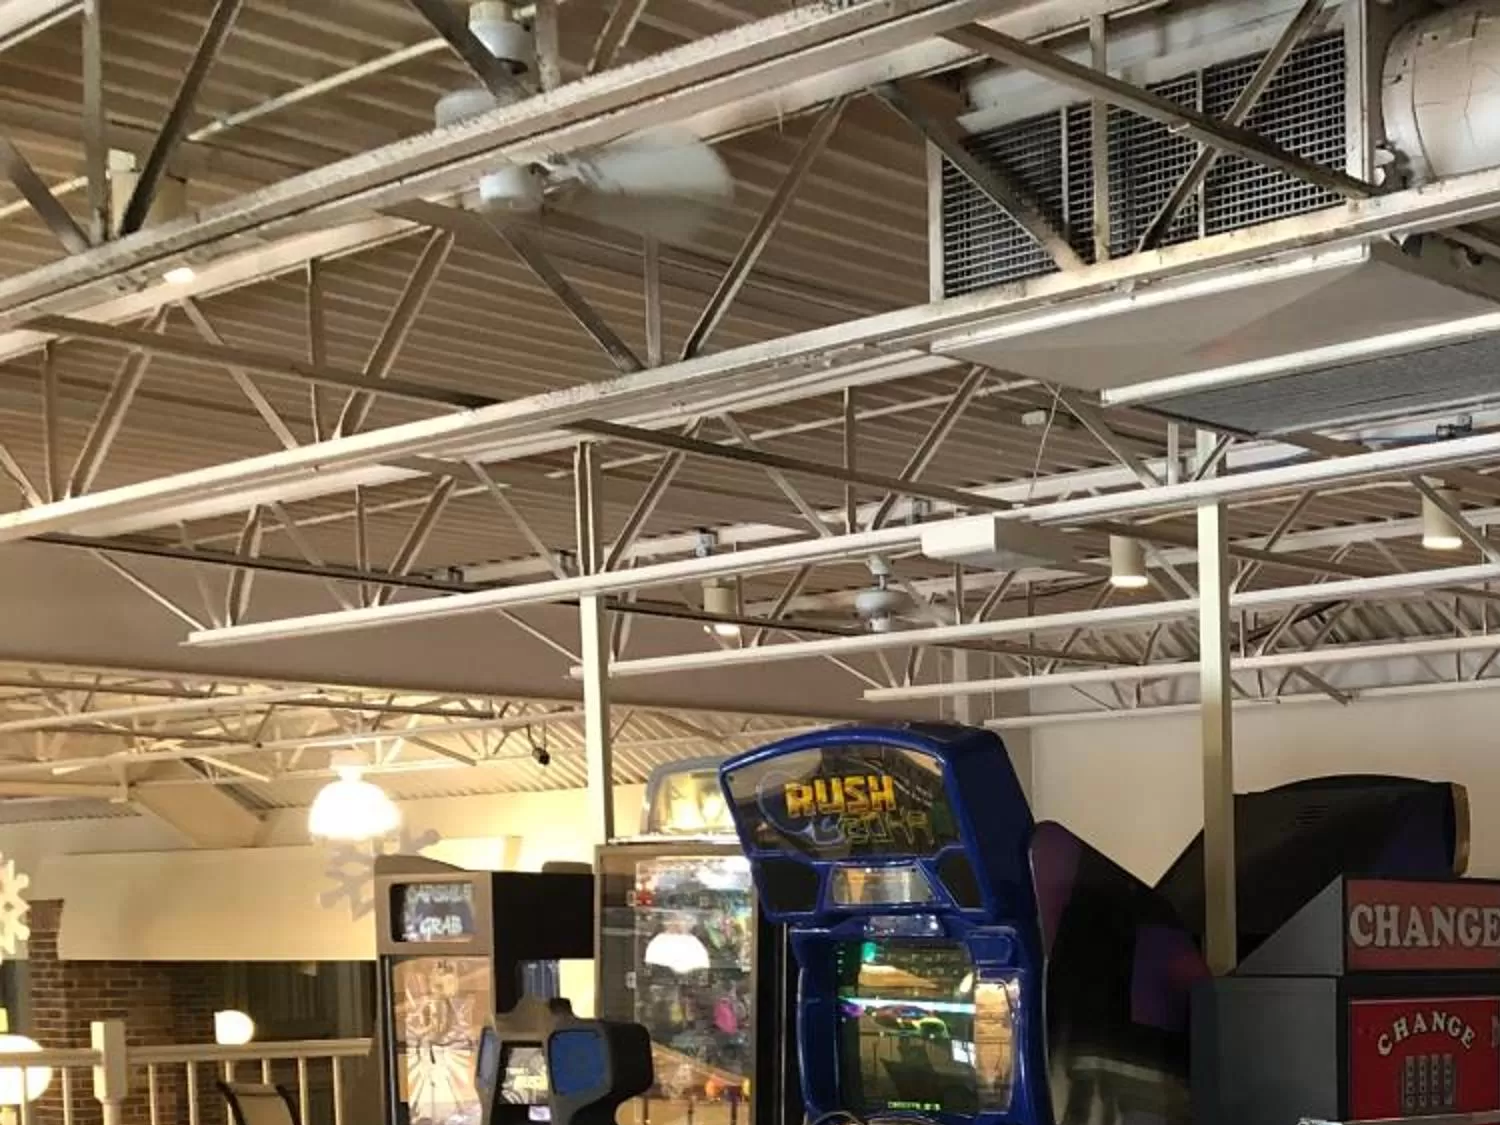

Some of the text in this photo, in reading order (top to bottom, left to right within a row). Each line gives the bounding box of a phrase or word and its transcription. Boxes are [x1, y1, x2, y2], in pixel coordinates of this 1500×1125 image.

[784, 775, 897, 819] RUSH
[420, 914, 463, 935] GRAB
[1377, 1010, 1475, 1056] CHANGE
